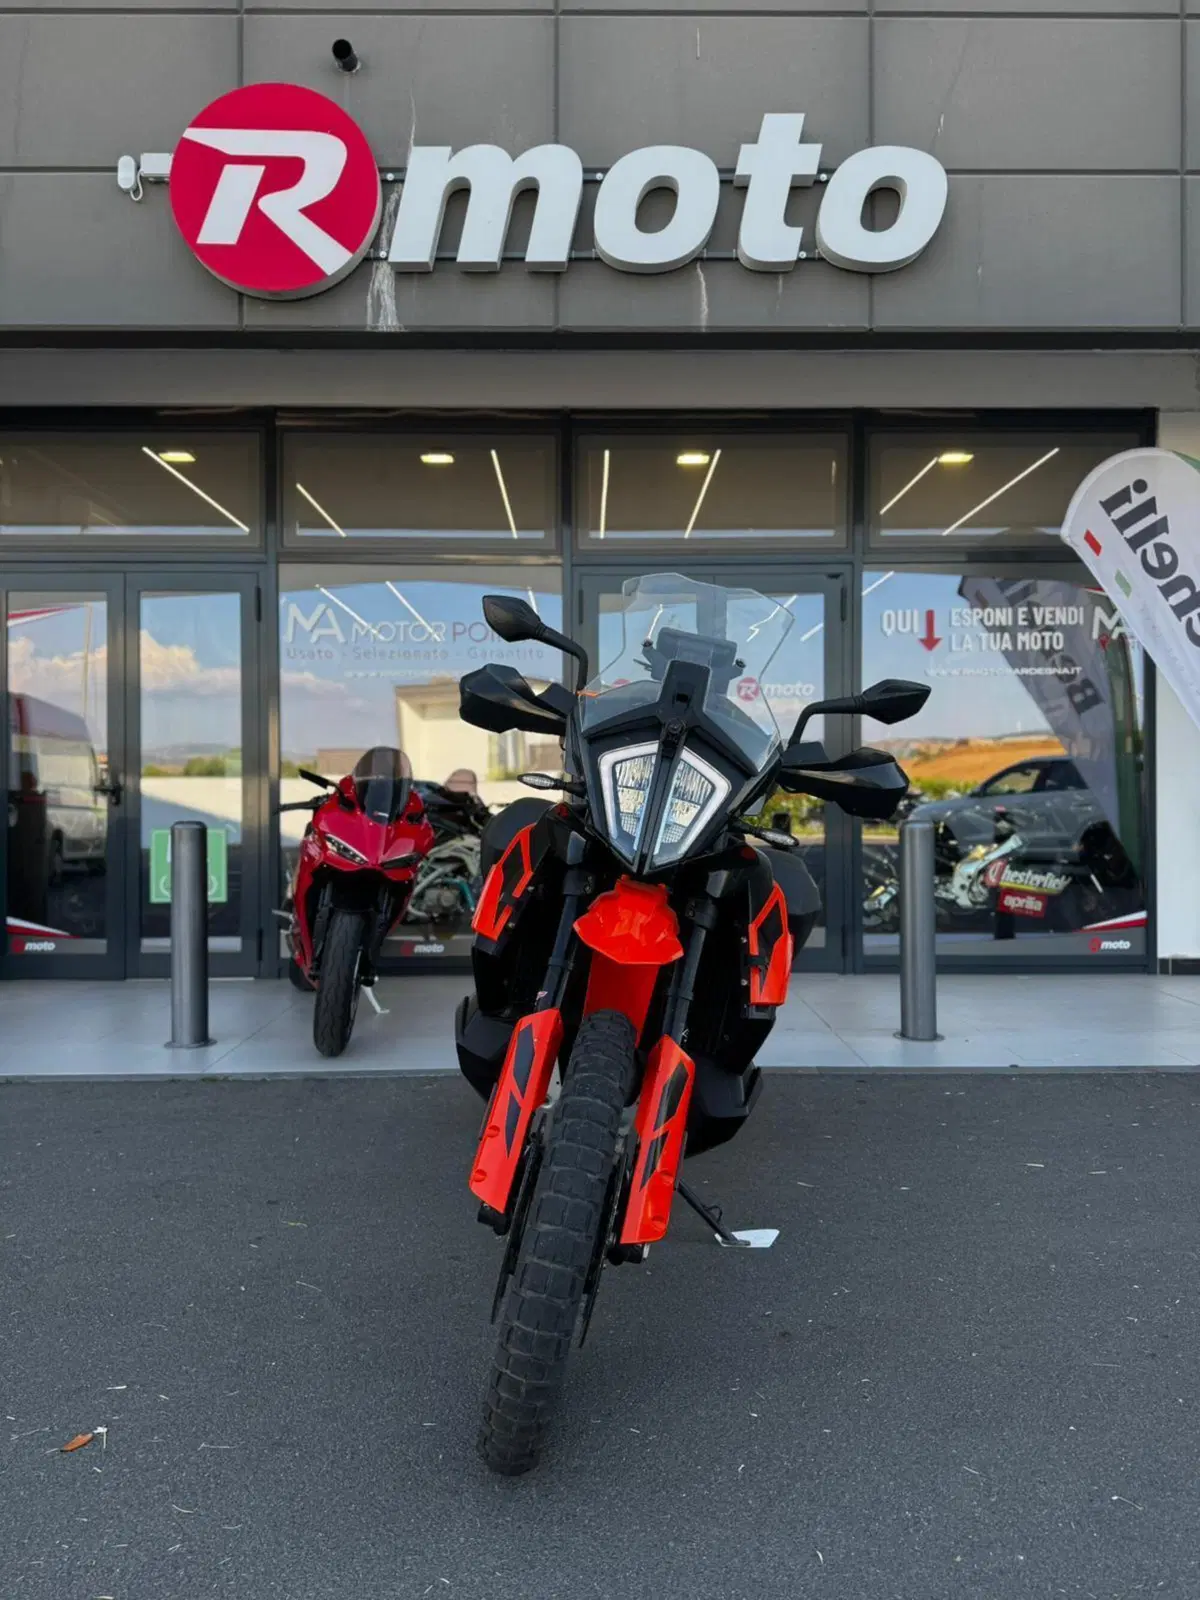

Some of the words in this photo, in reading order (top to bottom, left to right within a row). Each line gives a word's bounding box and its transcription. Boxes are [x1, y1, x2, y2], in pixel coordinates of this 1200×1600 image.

[882, 608, 920, 637] QUI
[951, 606, 1012, 627] ESPONI
[1017, 606, 1029, 626] E
[1031, 606, 1085, 626] VENDI
[351, 620, 446, 643] MOTOR
[951, 632, 974, 652] LA
[979, 631, 1012, 651] TUA
[1016, 630, 1065, 651] MOTO
[286, 647, 334, 660] Usato
[352, 646, 449, 660] Selezionato
[467, 645, 544, 660] Garantito
[1003, 895, 1043, 912] aprilia
